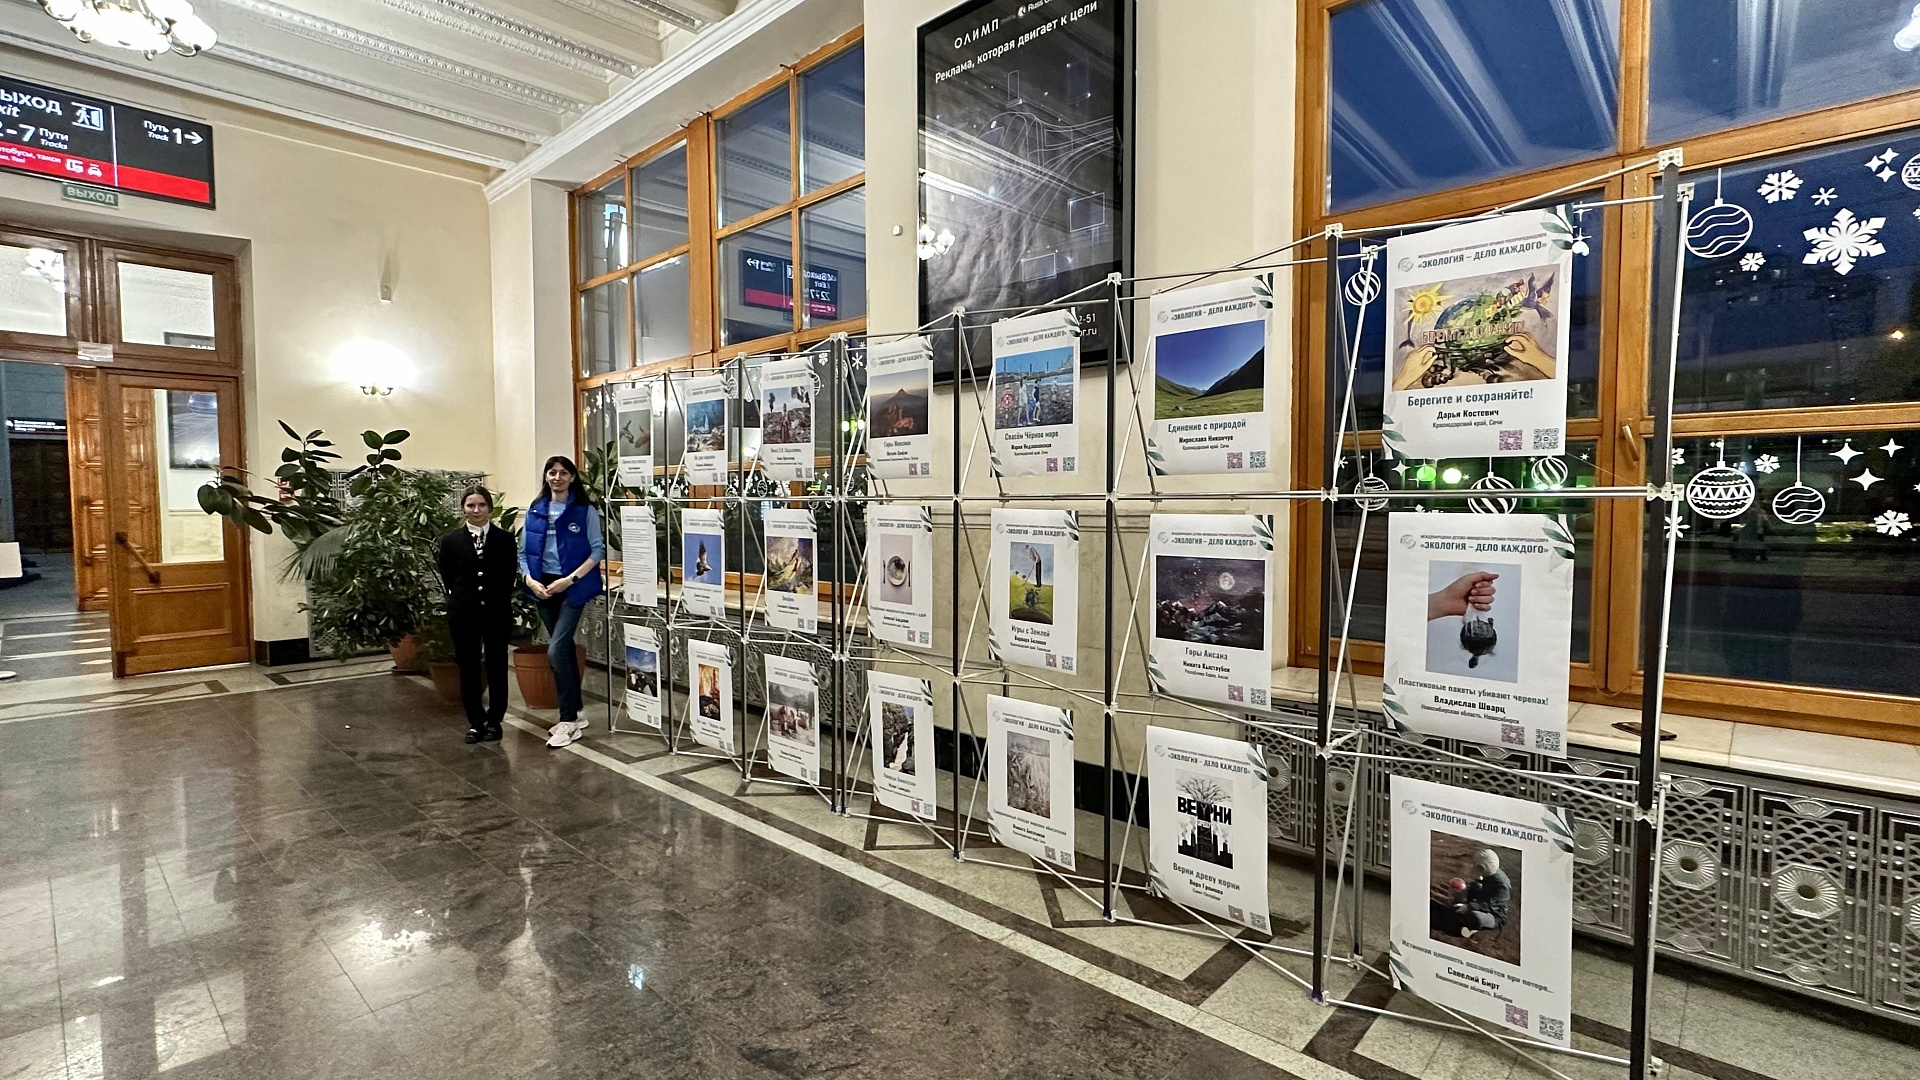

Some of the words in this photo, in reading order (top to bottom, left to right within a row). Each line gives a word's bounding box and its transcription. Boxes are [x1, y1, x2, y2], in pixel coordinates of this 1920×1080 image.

[935, 61, 975, 84] Реклама,
[977, 41, 1015, 65] которая
[1017, 18, 1059, 48] двигает
[1060, 16, 1068, 27] к
[1070, 1, 1098, 22] цели
[954, 18, 999, 49] ОЛИМП
[0, 88, 62, 116] ЫХОД
[0, 104, 20, 118] xit
[40, 127, 69, 141] Пути
[143, 119, 170, 134] Путь
[173, 127, 183, 145] 1
[147, 130, 170, 142] Track
[41, 138, 68, 150] Tracks
[66, 186, 116, 205] ВЫХОД
[1418, 254, 1464, 269] «ЭКОЛОГИЯ
[1473, 248, 1497, 262] ДЕЛО
[1499, 240, 1547, 256] КАЖДОГО»
[1171, 309, 1202, 321] «ЭКОЛОГИЯ
[1208, 307, 1224, 316] ДЕЛО
[1225, 301, 1256, 312] КАЖДОГО»
[1408, 396, 1453, 408] Берегите
[1466, 388, 1534, 404] сохраняйте!
[1437, 410, 1461, 420] Дарья
[1463, 409, 1499, 418] Костевич
[1168, 423, 1202, 433] Единение
[1210, 419, 1246, 431] природой
[1208, 538, 1224, 547] ДЕЛО
[1420, 541, 1467, 551] «ЭКОЛОГИЯ
[1475, 543, 1498, 553] ДЕЛО
[1501, 544, 1549, 554] КАЖДОГО»
[1185, 646, 1203, 657] Горы
[1204, 650, 1228, 660] Ансана
[1399, 677, 1446, 691] Пластиковые
[1448, 685, 1476, 696] пакеты
[1478, 689, 1510, 701] убивают
[1513, 694, 1549, 706] черепах!
[1434, 695, 1477, 709] Владислав
[1478, 702, 1506, 714] Шварц
[1204, 760, 1219, 769] ДЕЛО
[1421, 810, 1467, 826] «ЭКОЛОГИЯ
[1476, 821, 1499, 834] ДЕЛО
[1501, 827, 1549, 844] КАЖДОГО»
[1173, 862, 1194, 876] Верни
[1195, 871, 1216, 884] древу
[1218, 879, 1240, 891] корни
[1447, 966, 1480, 984] Савелий
[1482, 977, 1500, 990] Бирт
